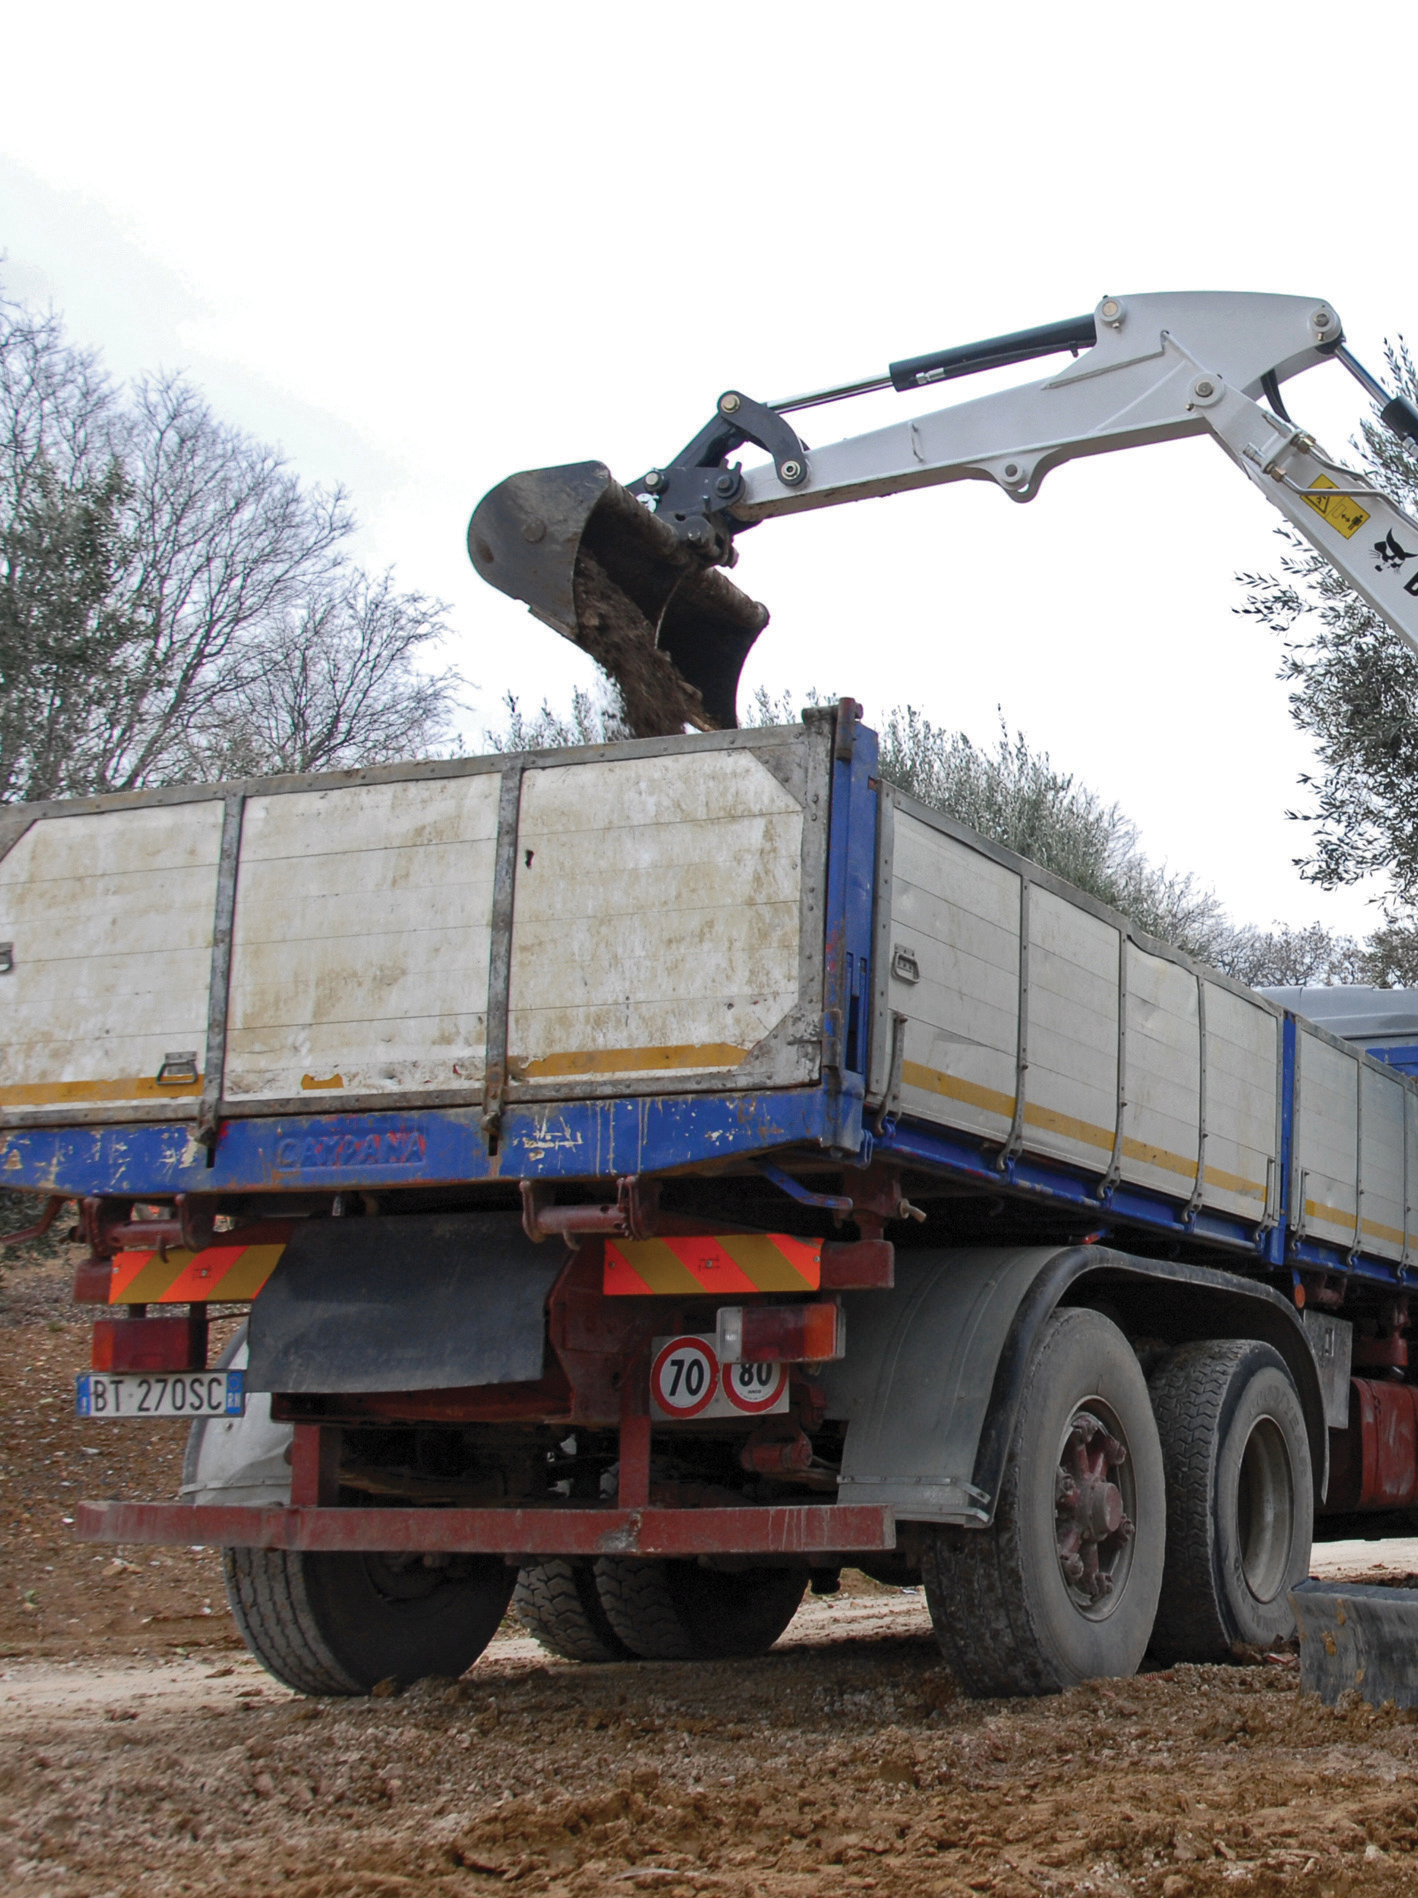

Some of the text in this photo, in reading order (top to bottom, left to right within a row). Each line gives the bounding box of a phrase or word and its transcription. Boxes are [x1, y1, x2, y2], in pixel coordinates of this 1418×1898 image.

[669, 1358, 705, 1397] 70
[739, 1363, 773, 1387] 80
[93, 1377, 223, 1412] BT 270SC
